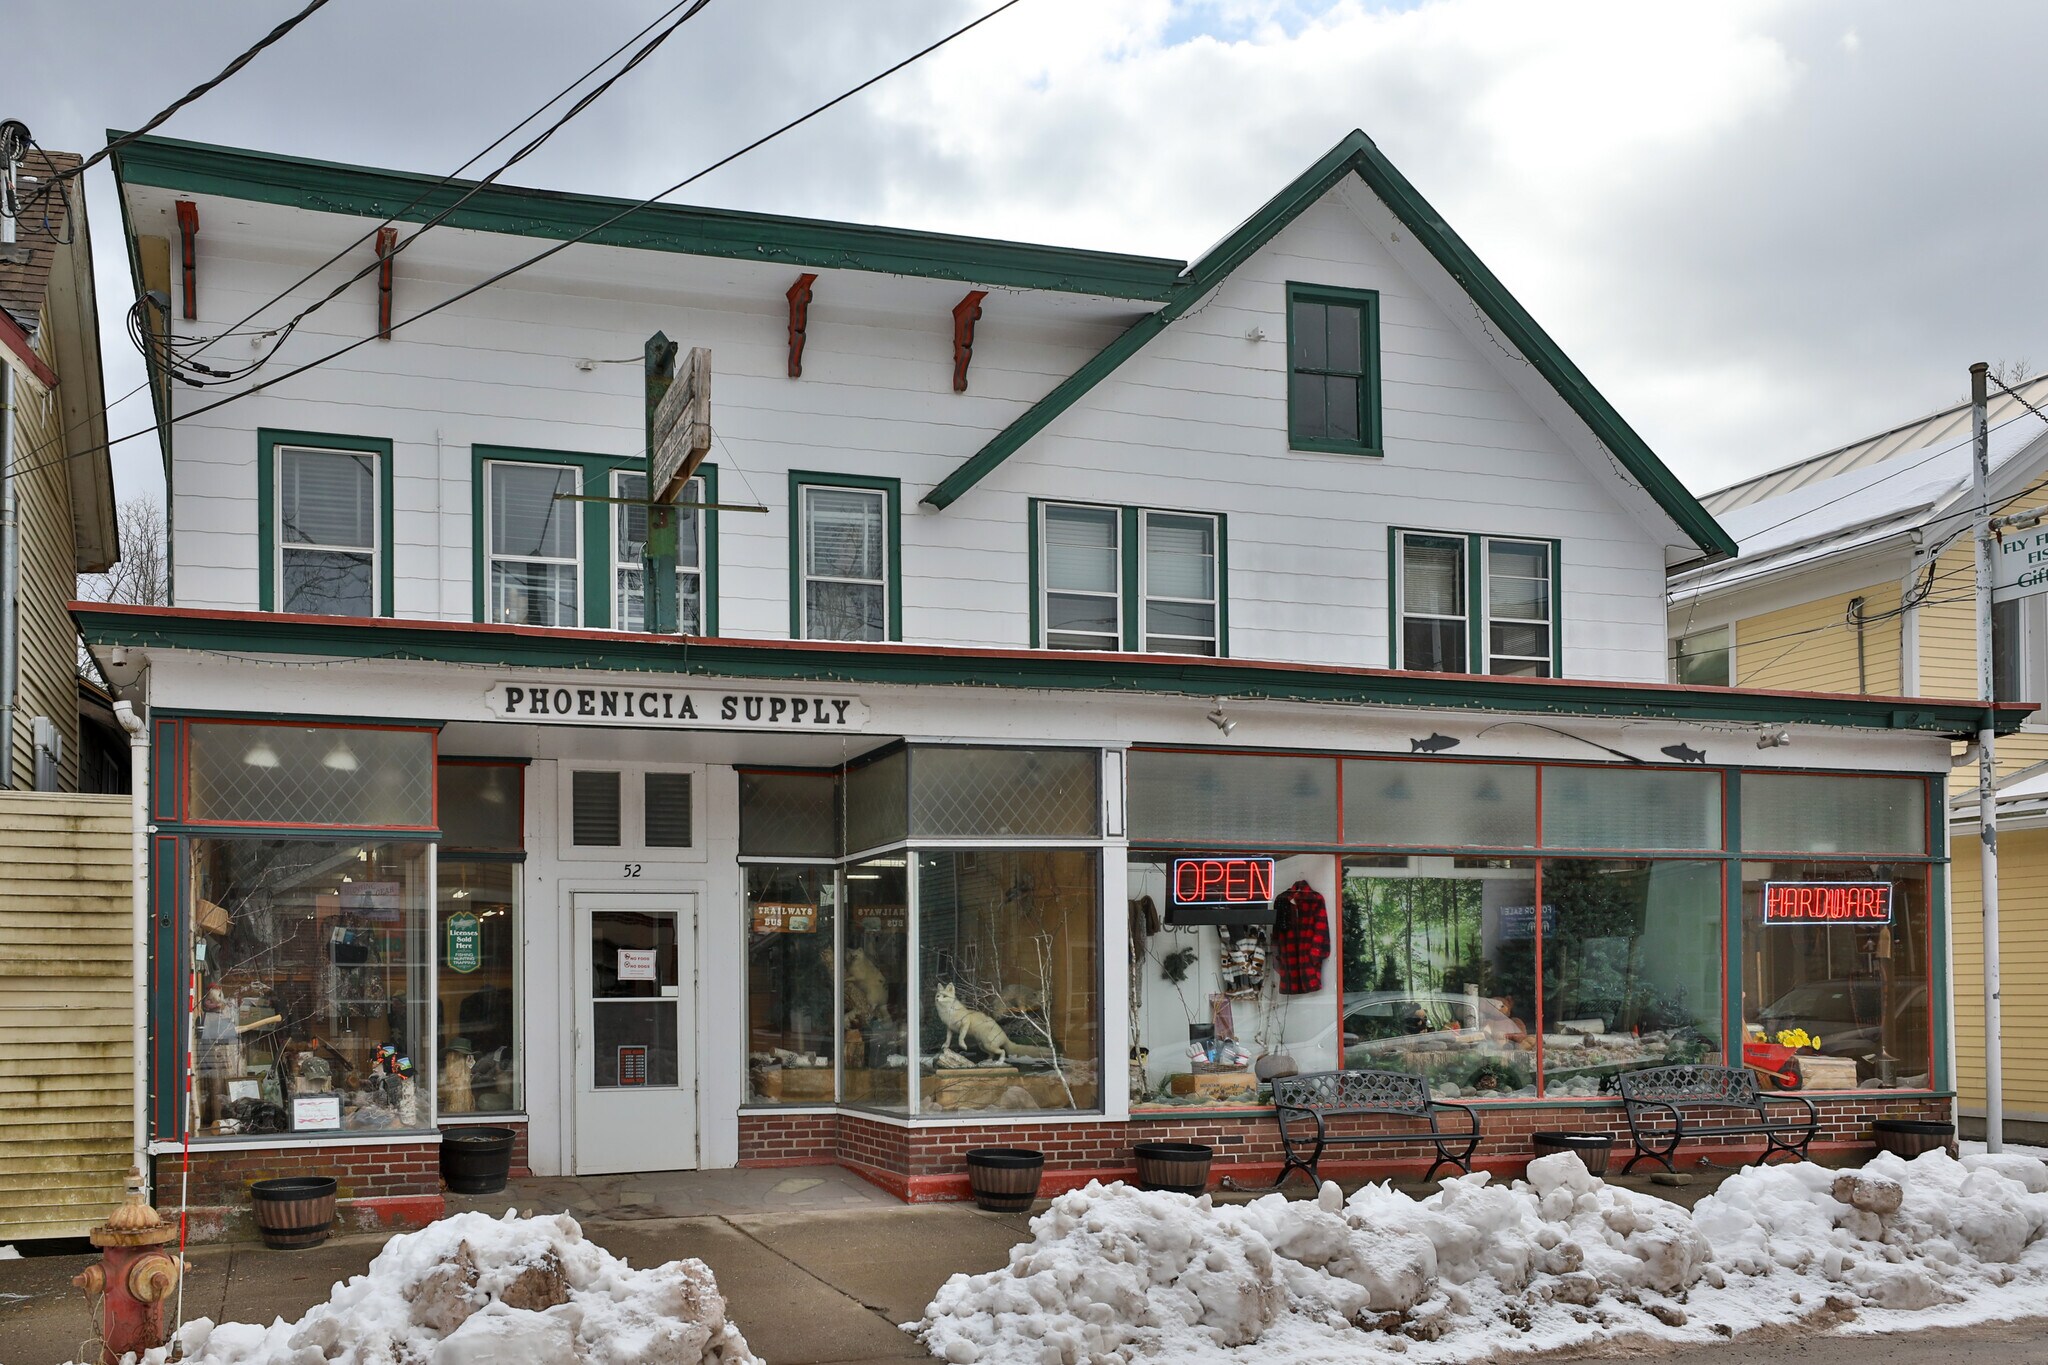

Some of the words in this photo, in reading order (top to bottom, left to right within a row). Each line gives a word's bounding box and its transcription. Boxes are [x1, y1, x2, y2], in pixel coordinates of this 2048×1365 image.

[2003, 538, 2028, 554] FLY
[2036, 533, 2048, 546] F
[505, 687, 698, 719] PHOENICIA
[721, 696, 850, 724] SUPPLY
[623, 863, 642, 878] 52
[1176, 860, 1273, 902] OPEN
[758, 906, 812, 915] TRAILWAYS
[1768, 887, 1888, 919] HARDWARE
[764, 918, 782, 927] BUS
